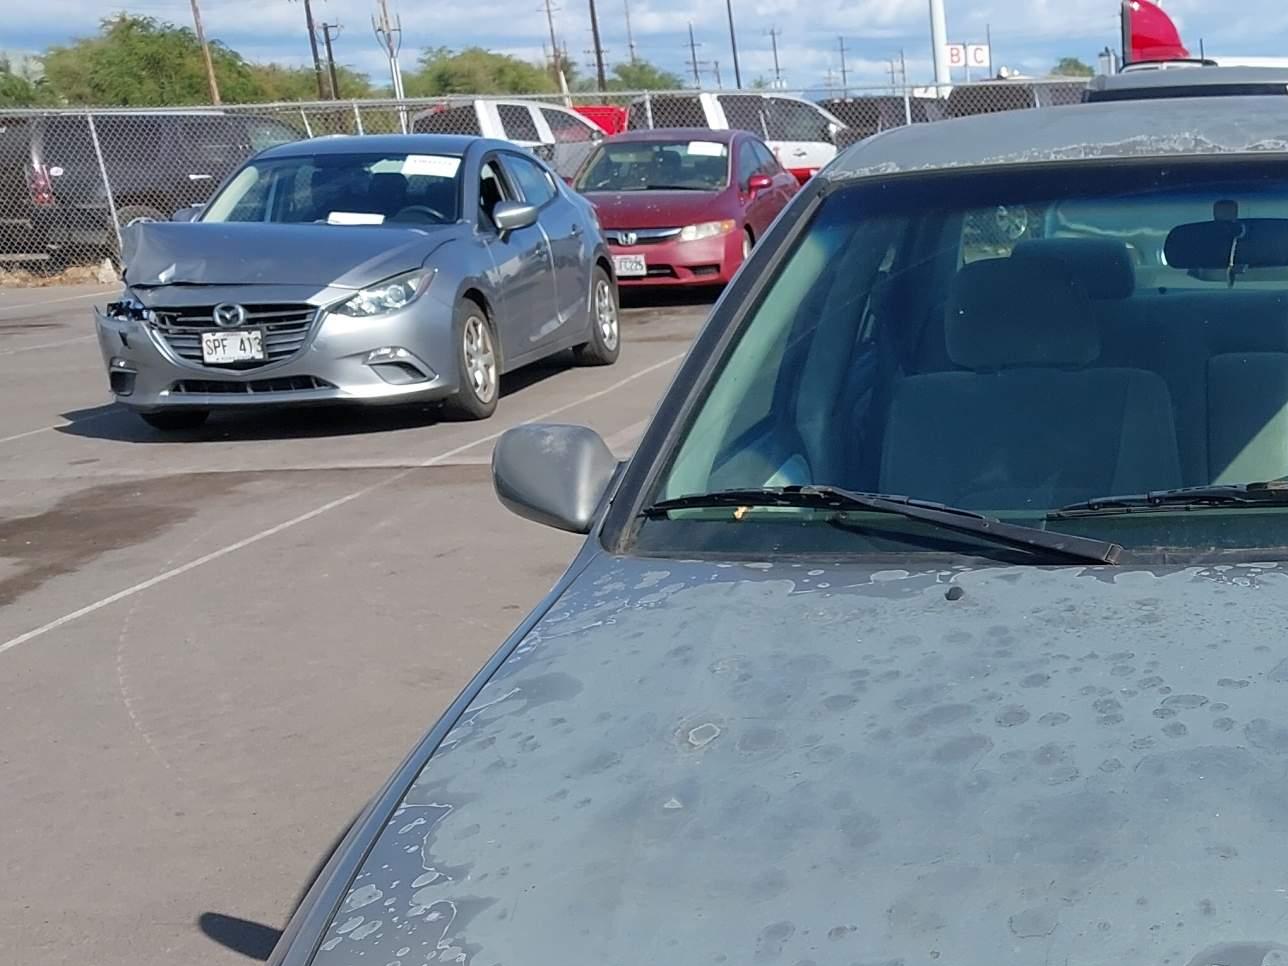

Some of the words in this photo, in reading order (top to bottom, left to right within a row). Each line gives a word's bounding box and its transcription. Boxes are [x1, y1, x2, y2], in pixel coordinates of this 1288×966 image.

[950, 47, 961, 64] B
[974, 47, 985, 64] C
[205, 338, 227, 355] SPF
[240, 336, 263, 353] 413
